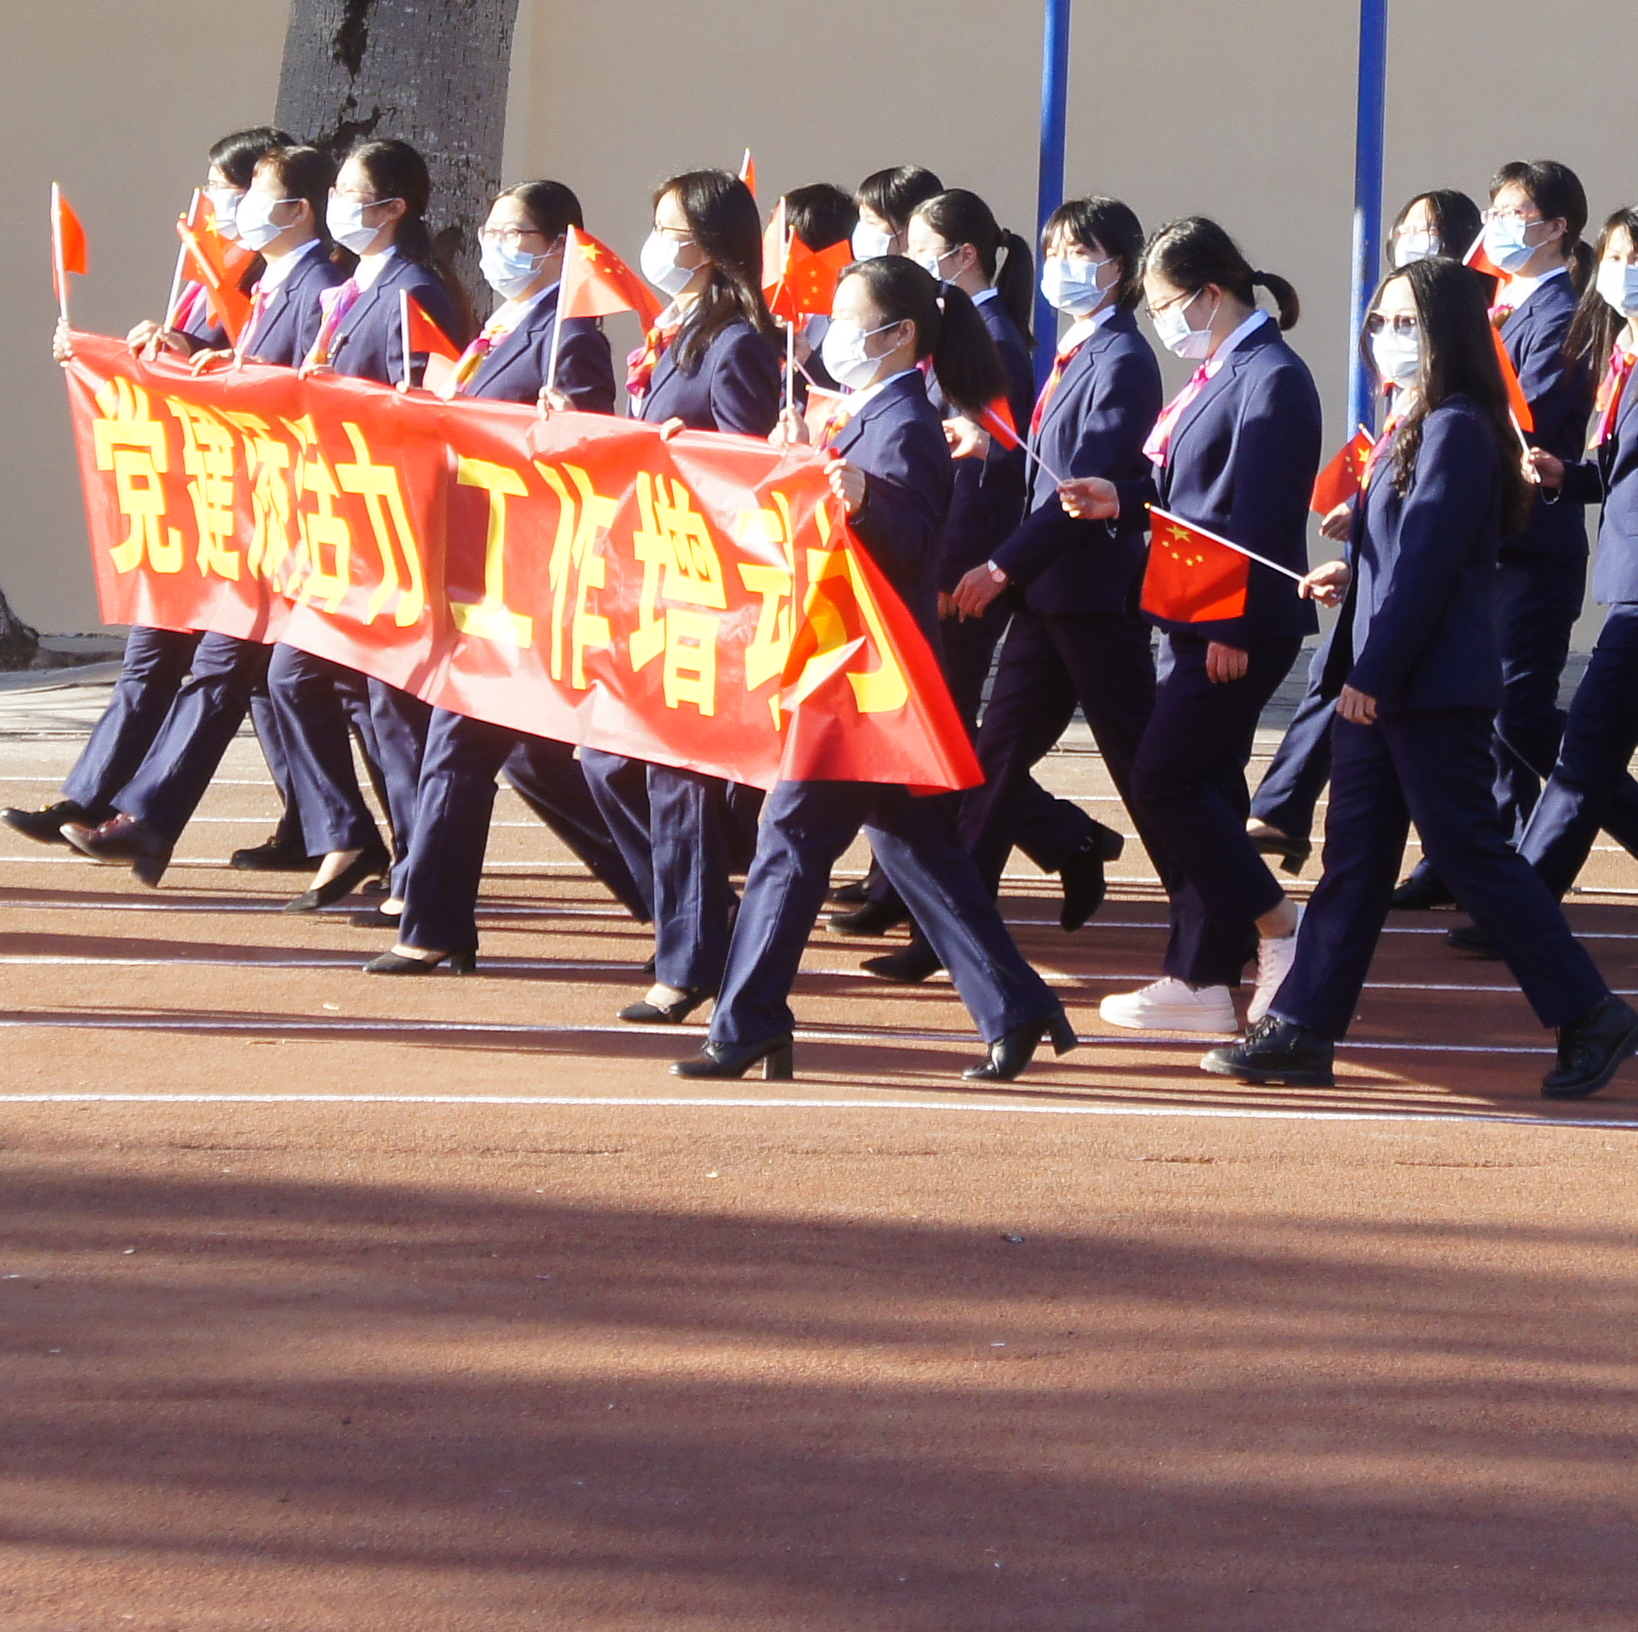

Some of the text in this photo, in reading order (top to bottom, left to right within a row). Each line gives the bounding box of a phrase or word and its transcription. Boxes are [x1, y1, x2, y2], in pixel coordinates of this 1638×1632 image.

[92, 375, 425, 628] 党建添活力
